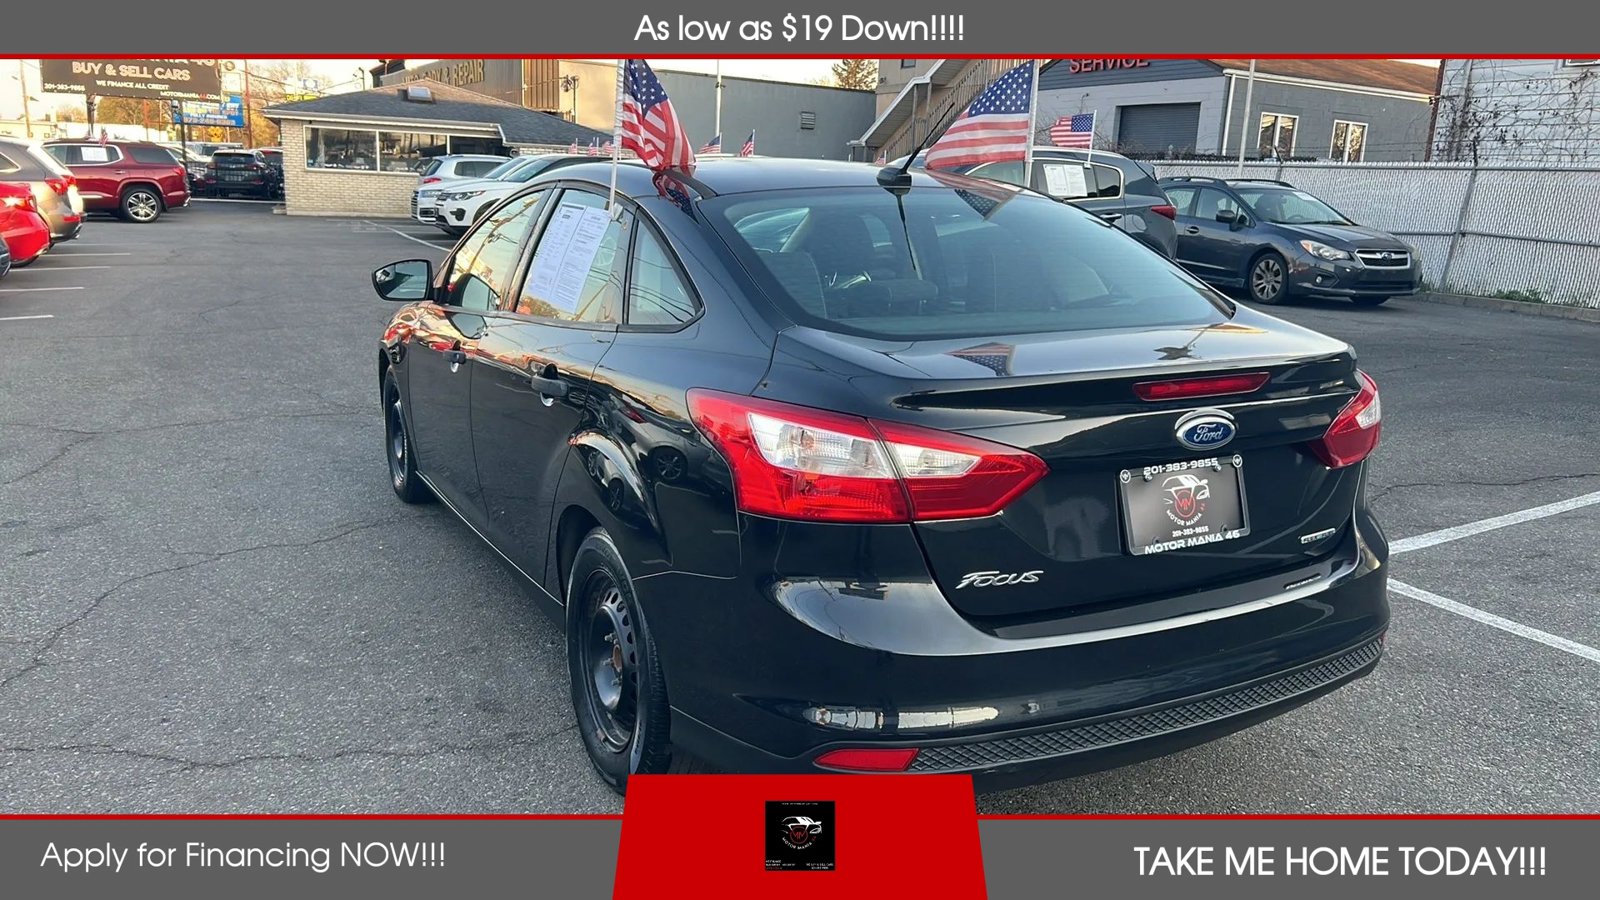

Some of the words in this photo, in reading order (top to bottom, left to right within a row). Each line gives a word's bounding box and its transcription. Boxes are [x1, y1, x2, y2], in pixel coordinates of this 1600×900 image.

[72, 61, 102, 75] BUY
[105, 64, 117, 77] &
[119, 65, 152, 79] SELL
[154, 67, 191, 81] CARS
[453, 59, 485, 87] REPAIR
[95, 79, 107, 87] WE
[107, 80, 134, 89] FINANCE
[134, 82, 147, 90] ALL
[147, 82, 169, 90] CREDIT
[1193, 423, 1224, 442] Ford
[1143, 458, 1219, 476] 201-383-9855
[1166, 509, 1185, 526] MOTOR
[1186, 512, 1202, 526] MANIA
[1144, 540, 1186, 555] MOTOR
[1187, 532, 1224, 547] MANIA
[1225, 529, 1240, 539] 46
